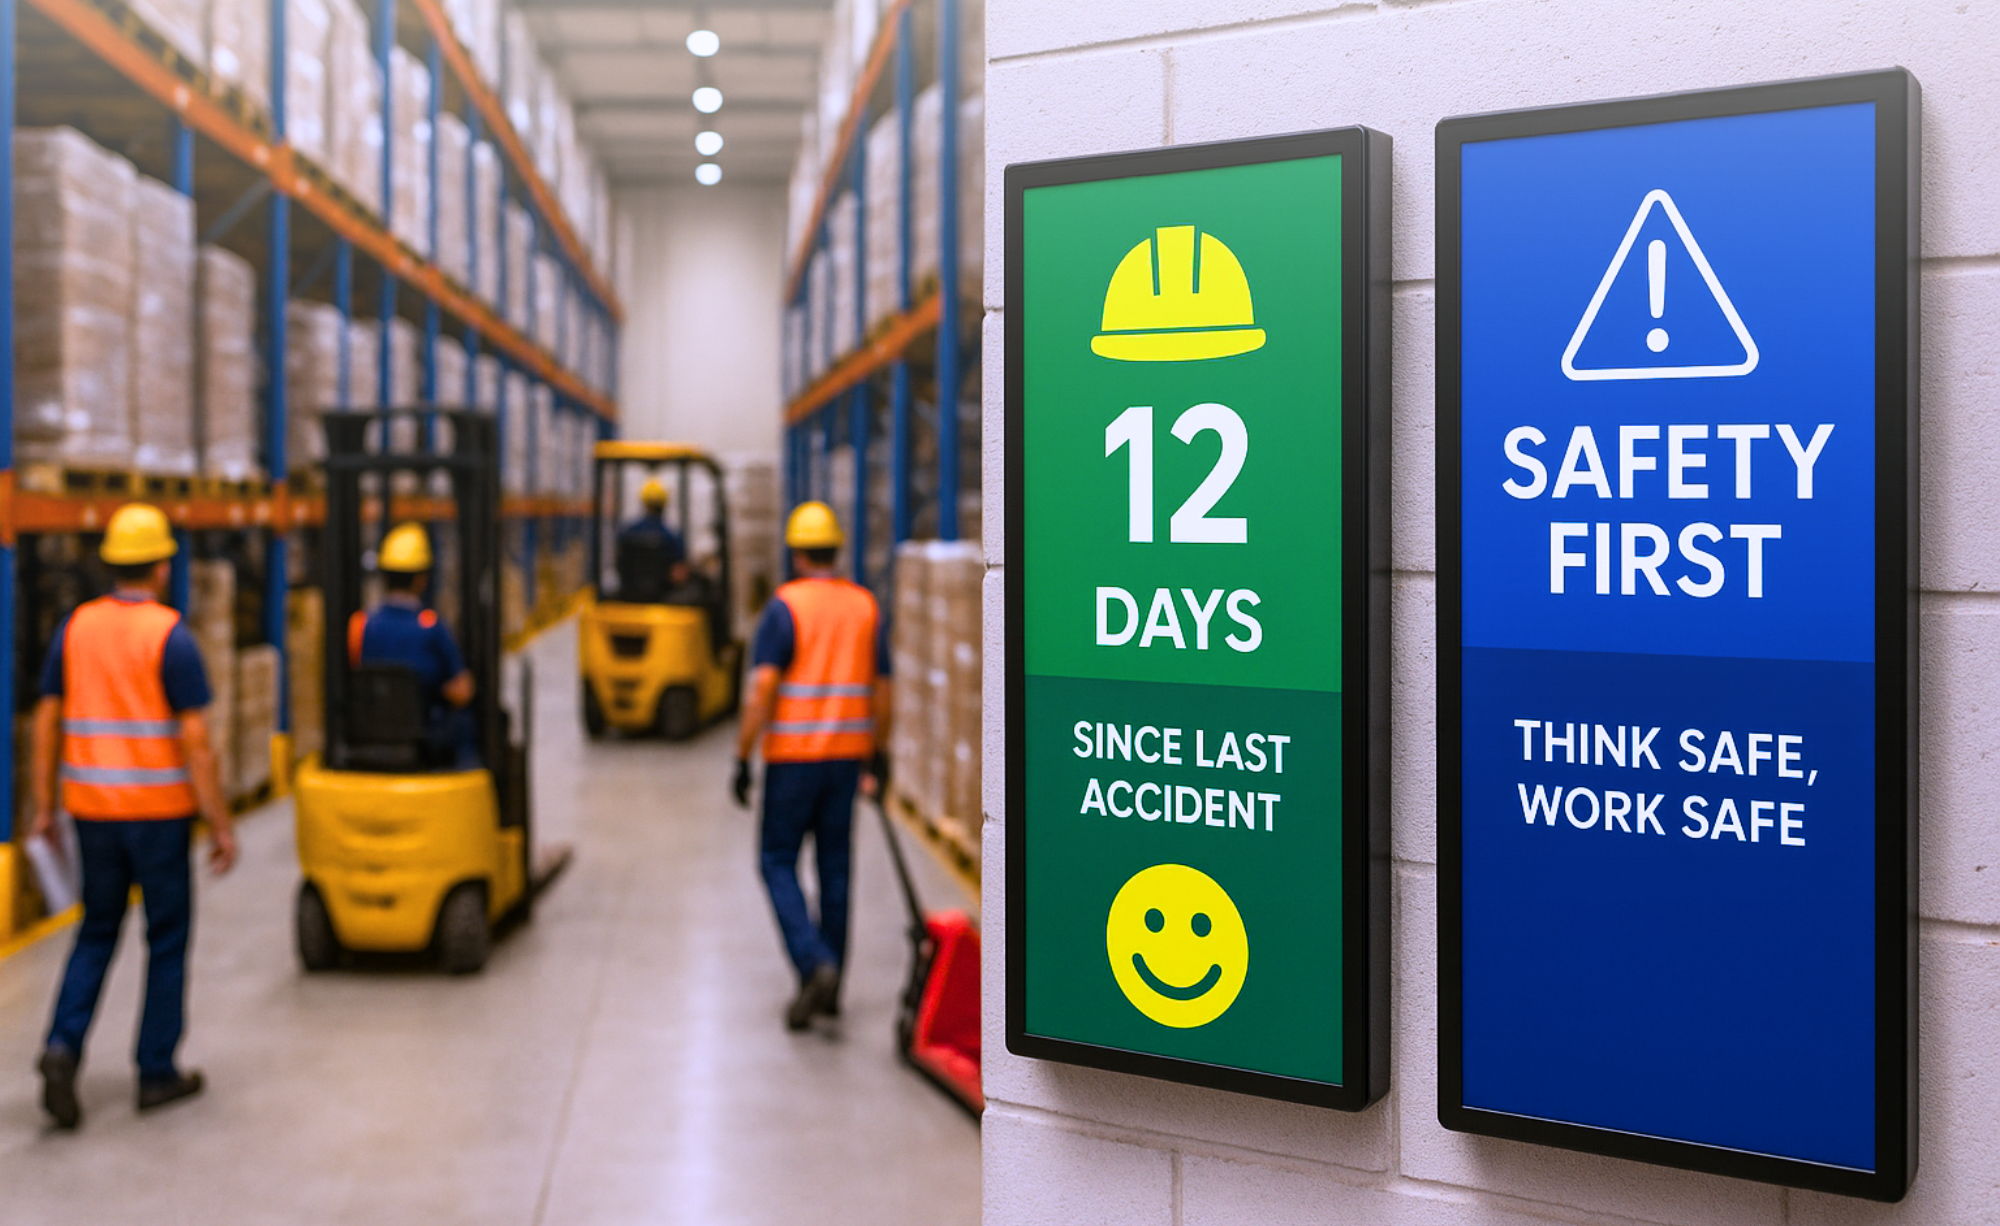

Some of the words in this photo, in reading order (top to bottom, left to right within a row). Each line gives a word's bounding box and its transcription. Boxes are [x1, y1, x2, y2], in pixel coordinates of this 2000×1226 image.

[1106, 403, 1247, 543] 12
[1503, 424, 1835, 499] SAFETY
[1551, 523, 1781, 597] FIRST
[1097, 587, 1262, 652] DAYS
[1074, 721, 1181, 764] SINCE
[1197, 730, 1290, 773] LAST
[1515, 720, 1660, 769] THINK
[1679, 729, 1817, 785] SAFE,
[1081, 779, 1280, 831] ACCIDENT
[1518, 784, 1665, 835] WORK
[1682, 796, 1805, 846] SAFE
